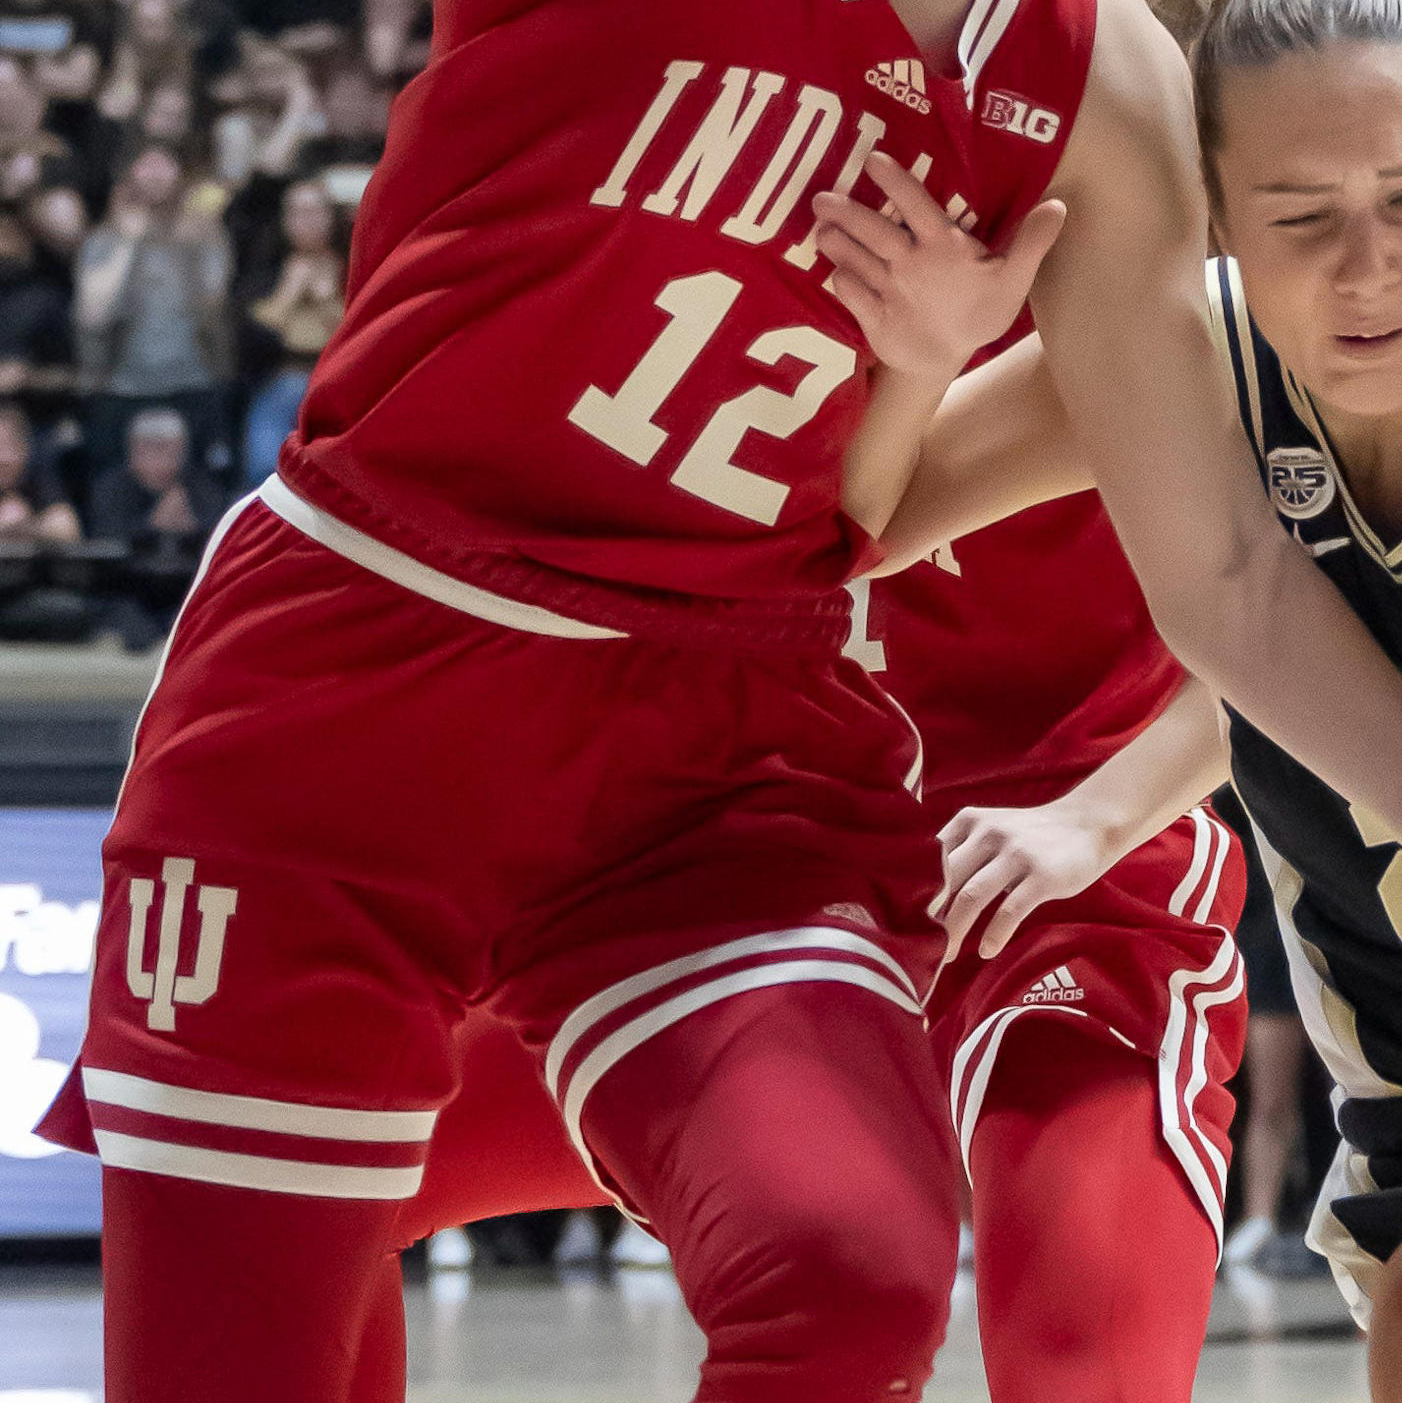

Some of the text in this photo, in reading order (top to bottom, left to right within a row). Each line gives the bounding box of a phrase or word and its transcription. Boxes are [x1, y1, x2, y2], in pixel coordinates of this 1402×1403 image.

[864, 68, 932, 115] adidas
[589, 58, 978, 296] INDI
[567, 270, 857, 527] 12
[1023, 987, 1084, 1004] adidas
